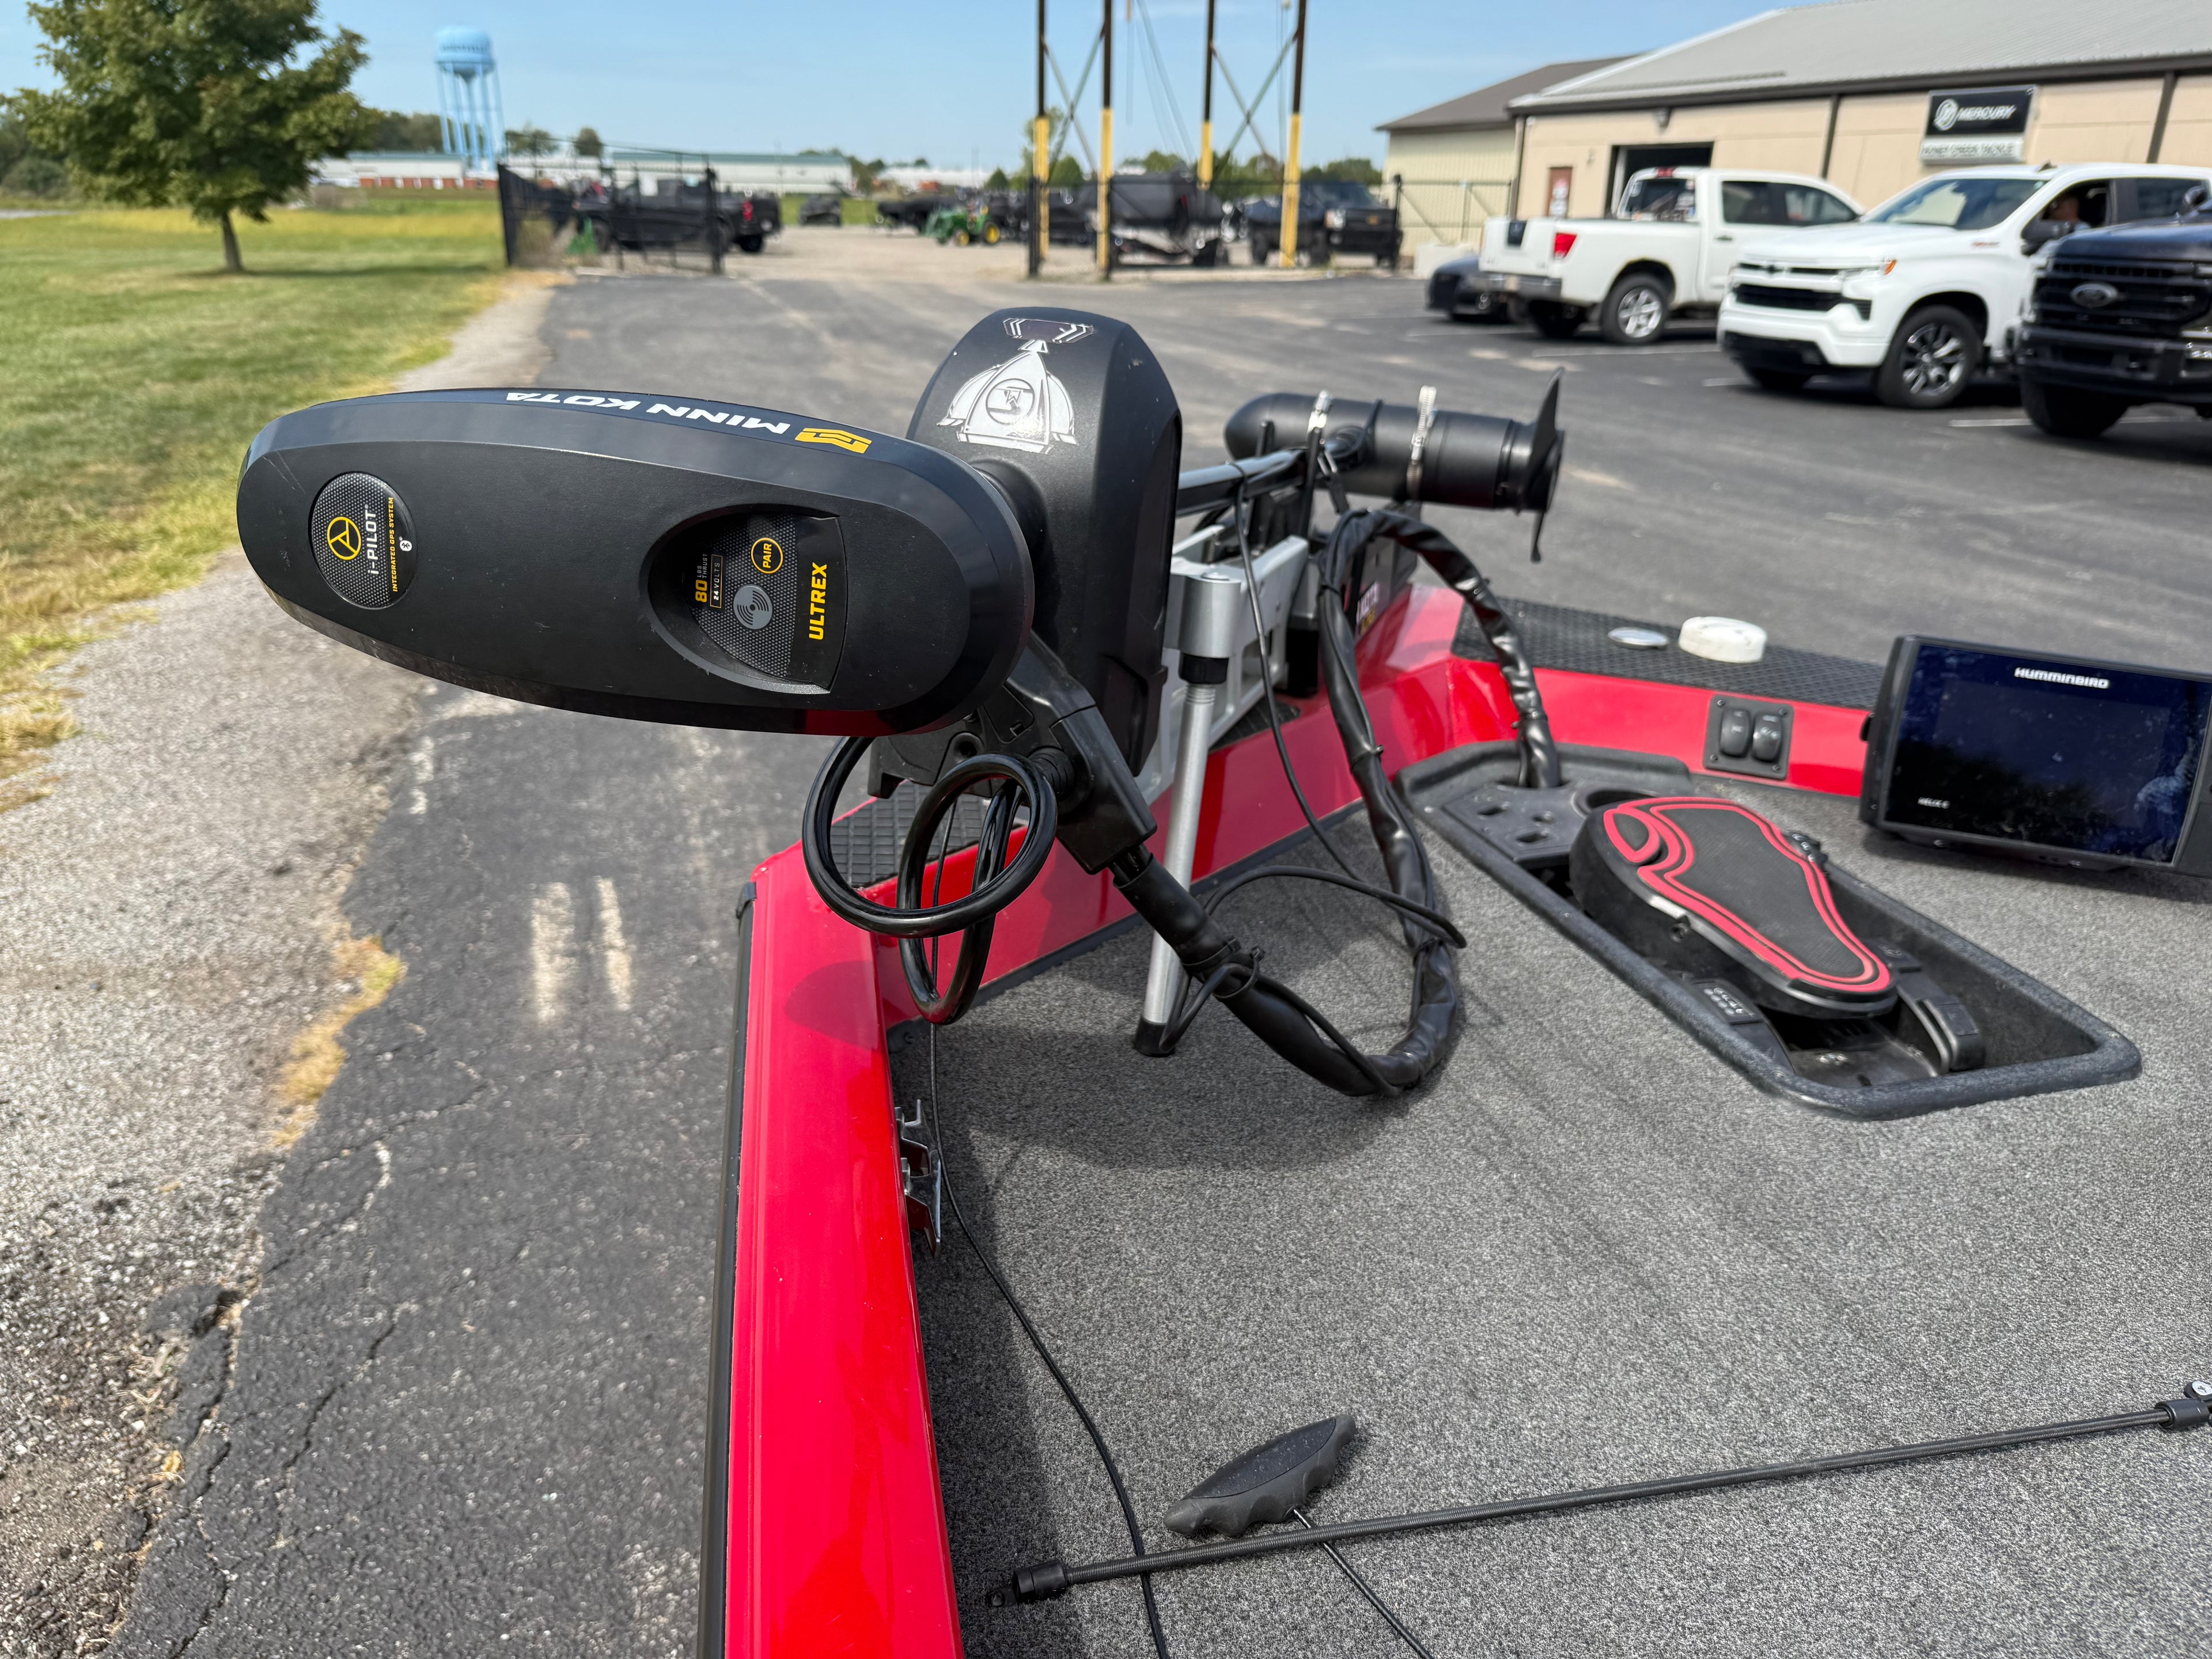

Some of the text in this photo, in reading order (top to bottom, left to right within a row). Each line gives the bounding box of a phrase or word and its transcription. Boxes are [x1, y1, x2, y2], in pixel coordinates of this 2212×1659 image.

[1958, 104, 2016, 121] MERCURY
[506, 392, 791, 434] MINN KOTA
[763, 543, 772, 569] PAIR
[389, 546, 398, 592] INTEGRATED
[695, 579, 707, 603] 80
[714, 590, 719, 600] 24
[809, 562, 827, 641] ULTREX
[2014, 667, 2111, 690] HUMMINBIRD
